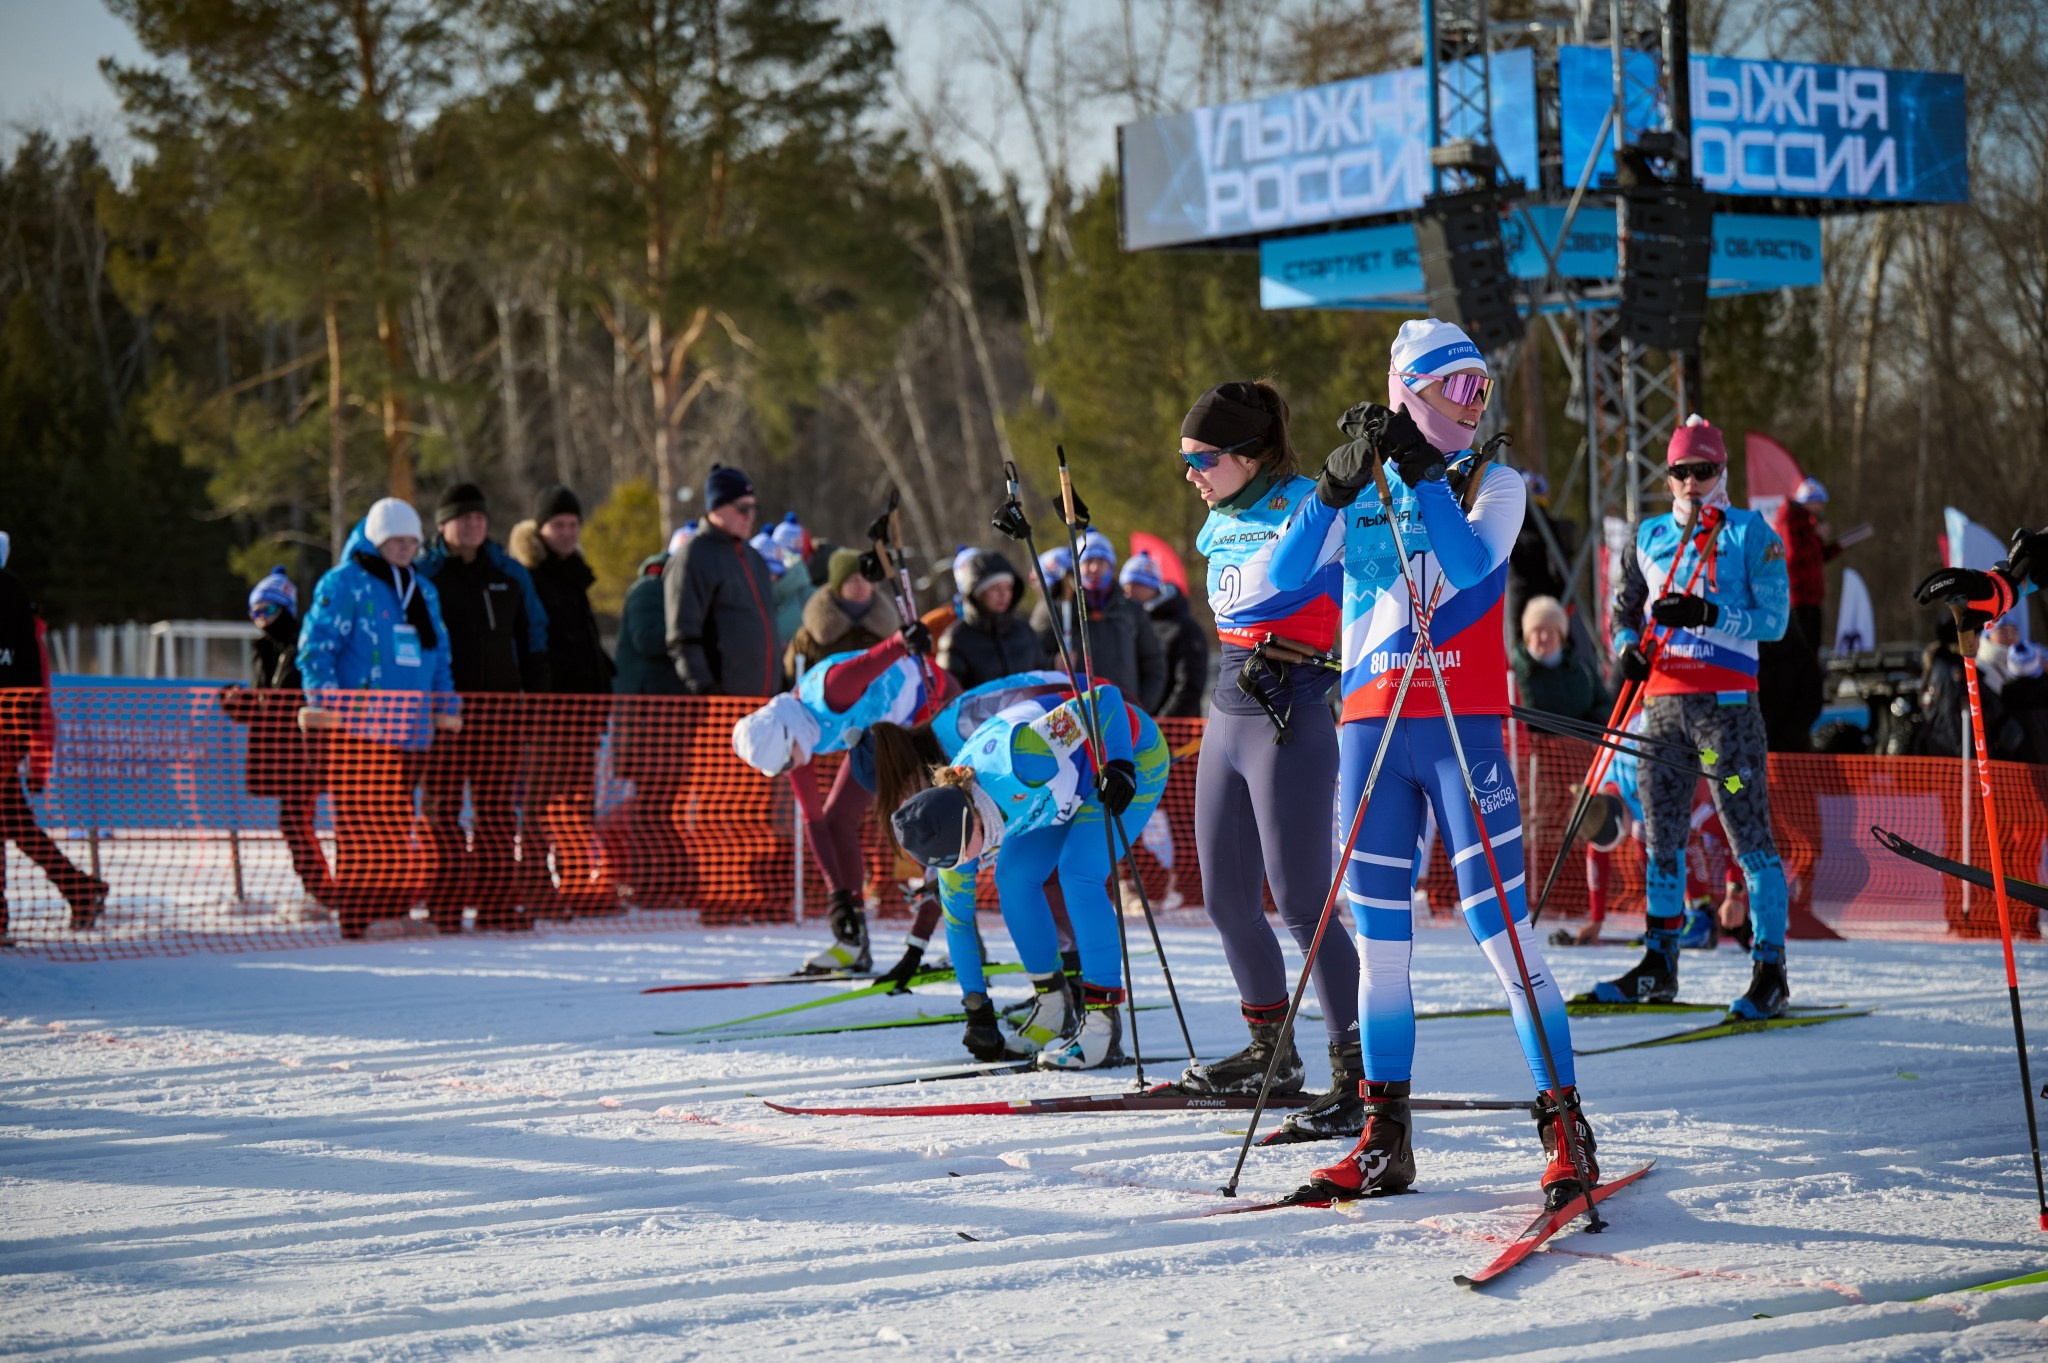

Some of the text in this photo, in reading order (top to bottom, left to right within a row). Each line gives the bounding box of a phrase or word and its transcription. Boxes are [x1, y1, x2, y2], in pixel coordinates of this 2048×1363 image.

[1690, 60, 1889, 131] ЫЖНЯ
[1691, 126, 1897, 197] ОССИИ
[1206, 140, 1434, 233] РОССИ
[1724, 236, 1813, 261] ОБЛАСТЬ
[1238, 530, 1279, 543] РОССИИ
[1219, 564, 1241, 623] 2
[1400, 550, 1426, 635] 1
[1370, 651, 1388, 675] 80
[1480, 786, 1512, 808] ВСМПО
[1480, 793, 1516, 815] АВИСМА
